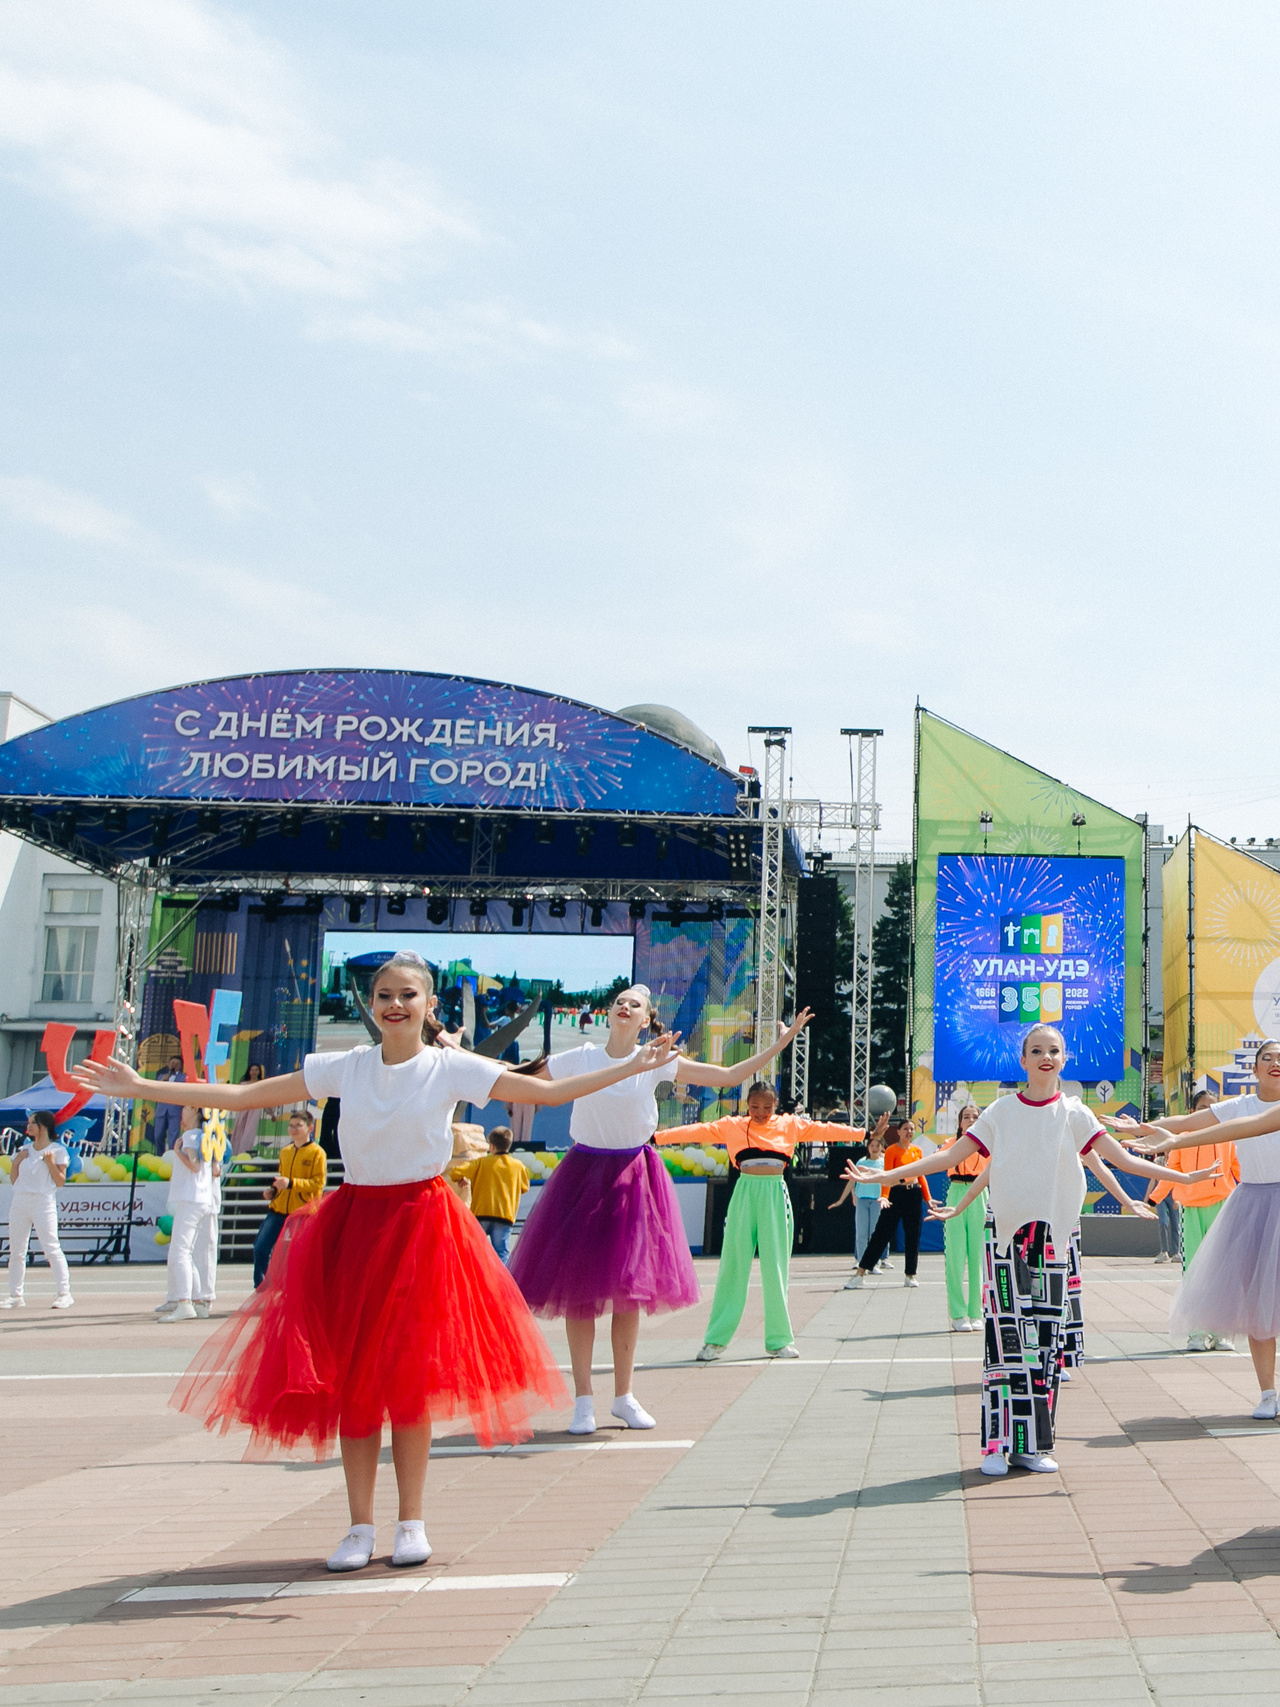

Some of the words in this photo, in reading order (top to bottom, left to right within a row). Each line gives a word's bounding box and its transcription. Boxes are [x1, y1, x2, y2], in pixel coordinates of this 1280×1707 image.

[174, 709, 201, 737] С
[209, 707, 323, 741] ДНЁМ
[335, 714, 566, 752] РОЖДЕНИЯ,
[182, 750, 397, 783] ЛЮБИМЫЙ
[408, 757, 547, 790] ГОРОД!
[972, 959, 1090, 980] УЛАН-УДЭ
[975, 987, 996, 998] 1666
[1001, 986, 1061, 1013] 356
[1065, 988, 1089, 998] 2022
[1000, 1268, 1009, 1307] DANCE
